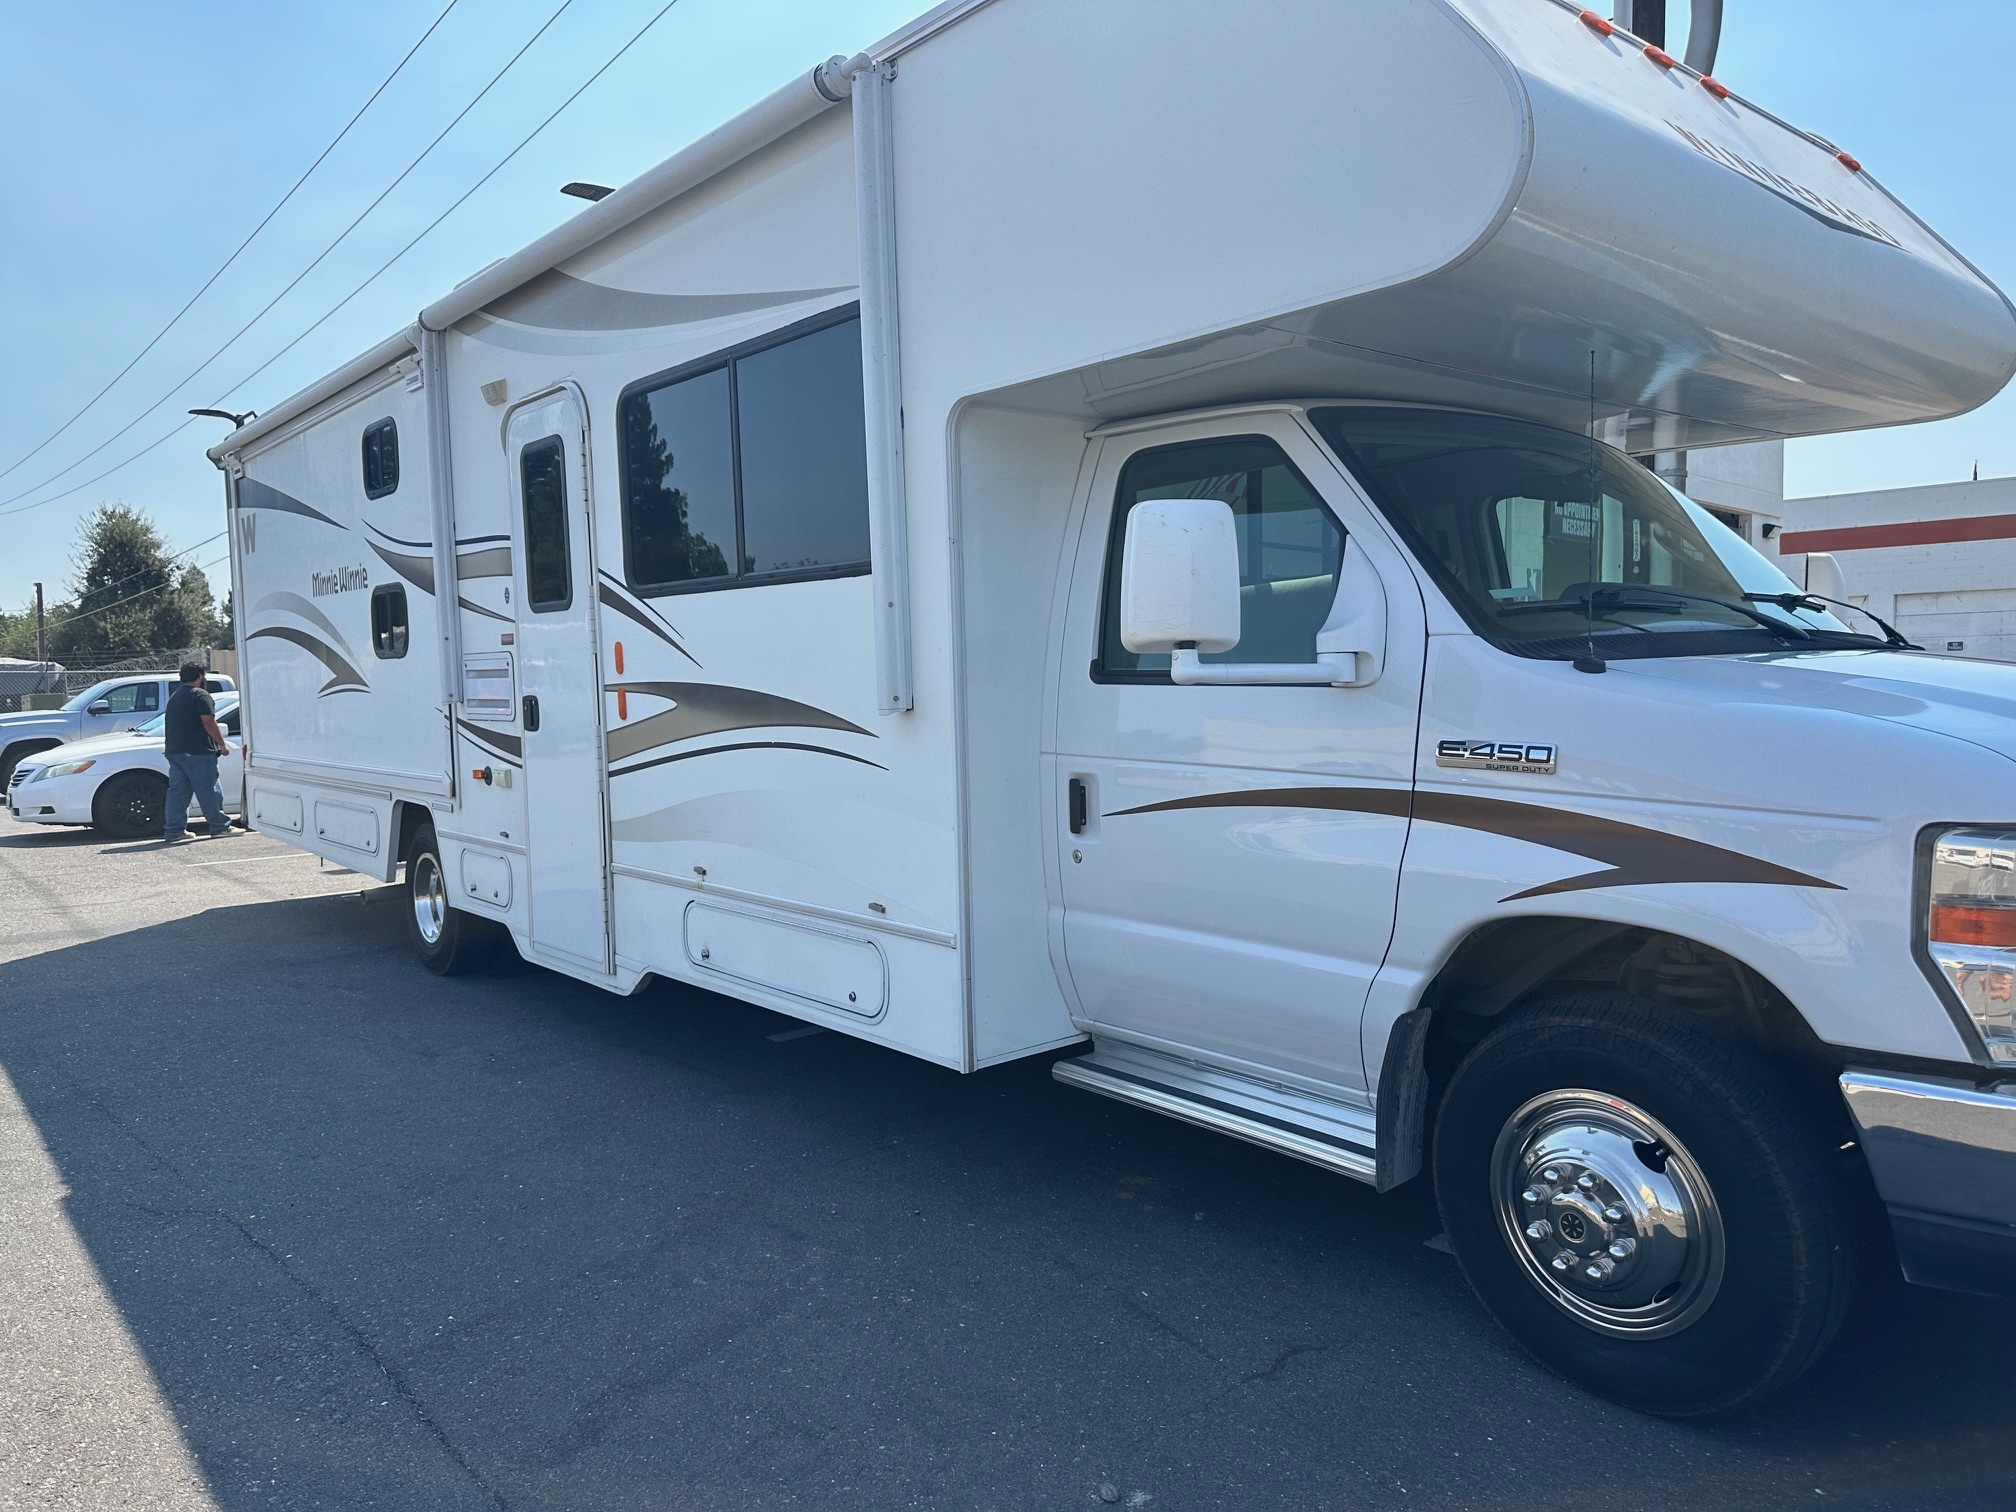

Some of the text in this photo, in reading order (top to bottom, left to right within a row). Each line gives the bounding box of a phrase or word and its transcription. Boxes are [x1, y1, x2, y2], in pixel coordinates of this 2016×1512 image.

[1661, 118, 1902, 247] WINNEBAGO
[241, 512, 257, 555] W
[311, 563, 368, 598] Minnie Winnie
[1437, 740, 1553, 764] E-450
[1485, 763, 1519, 772] SUPER
